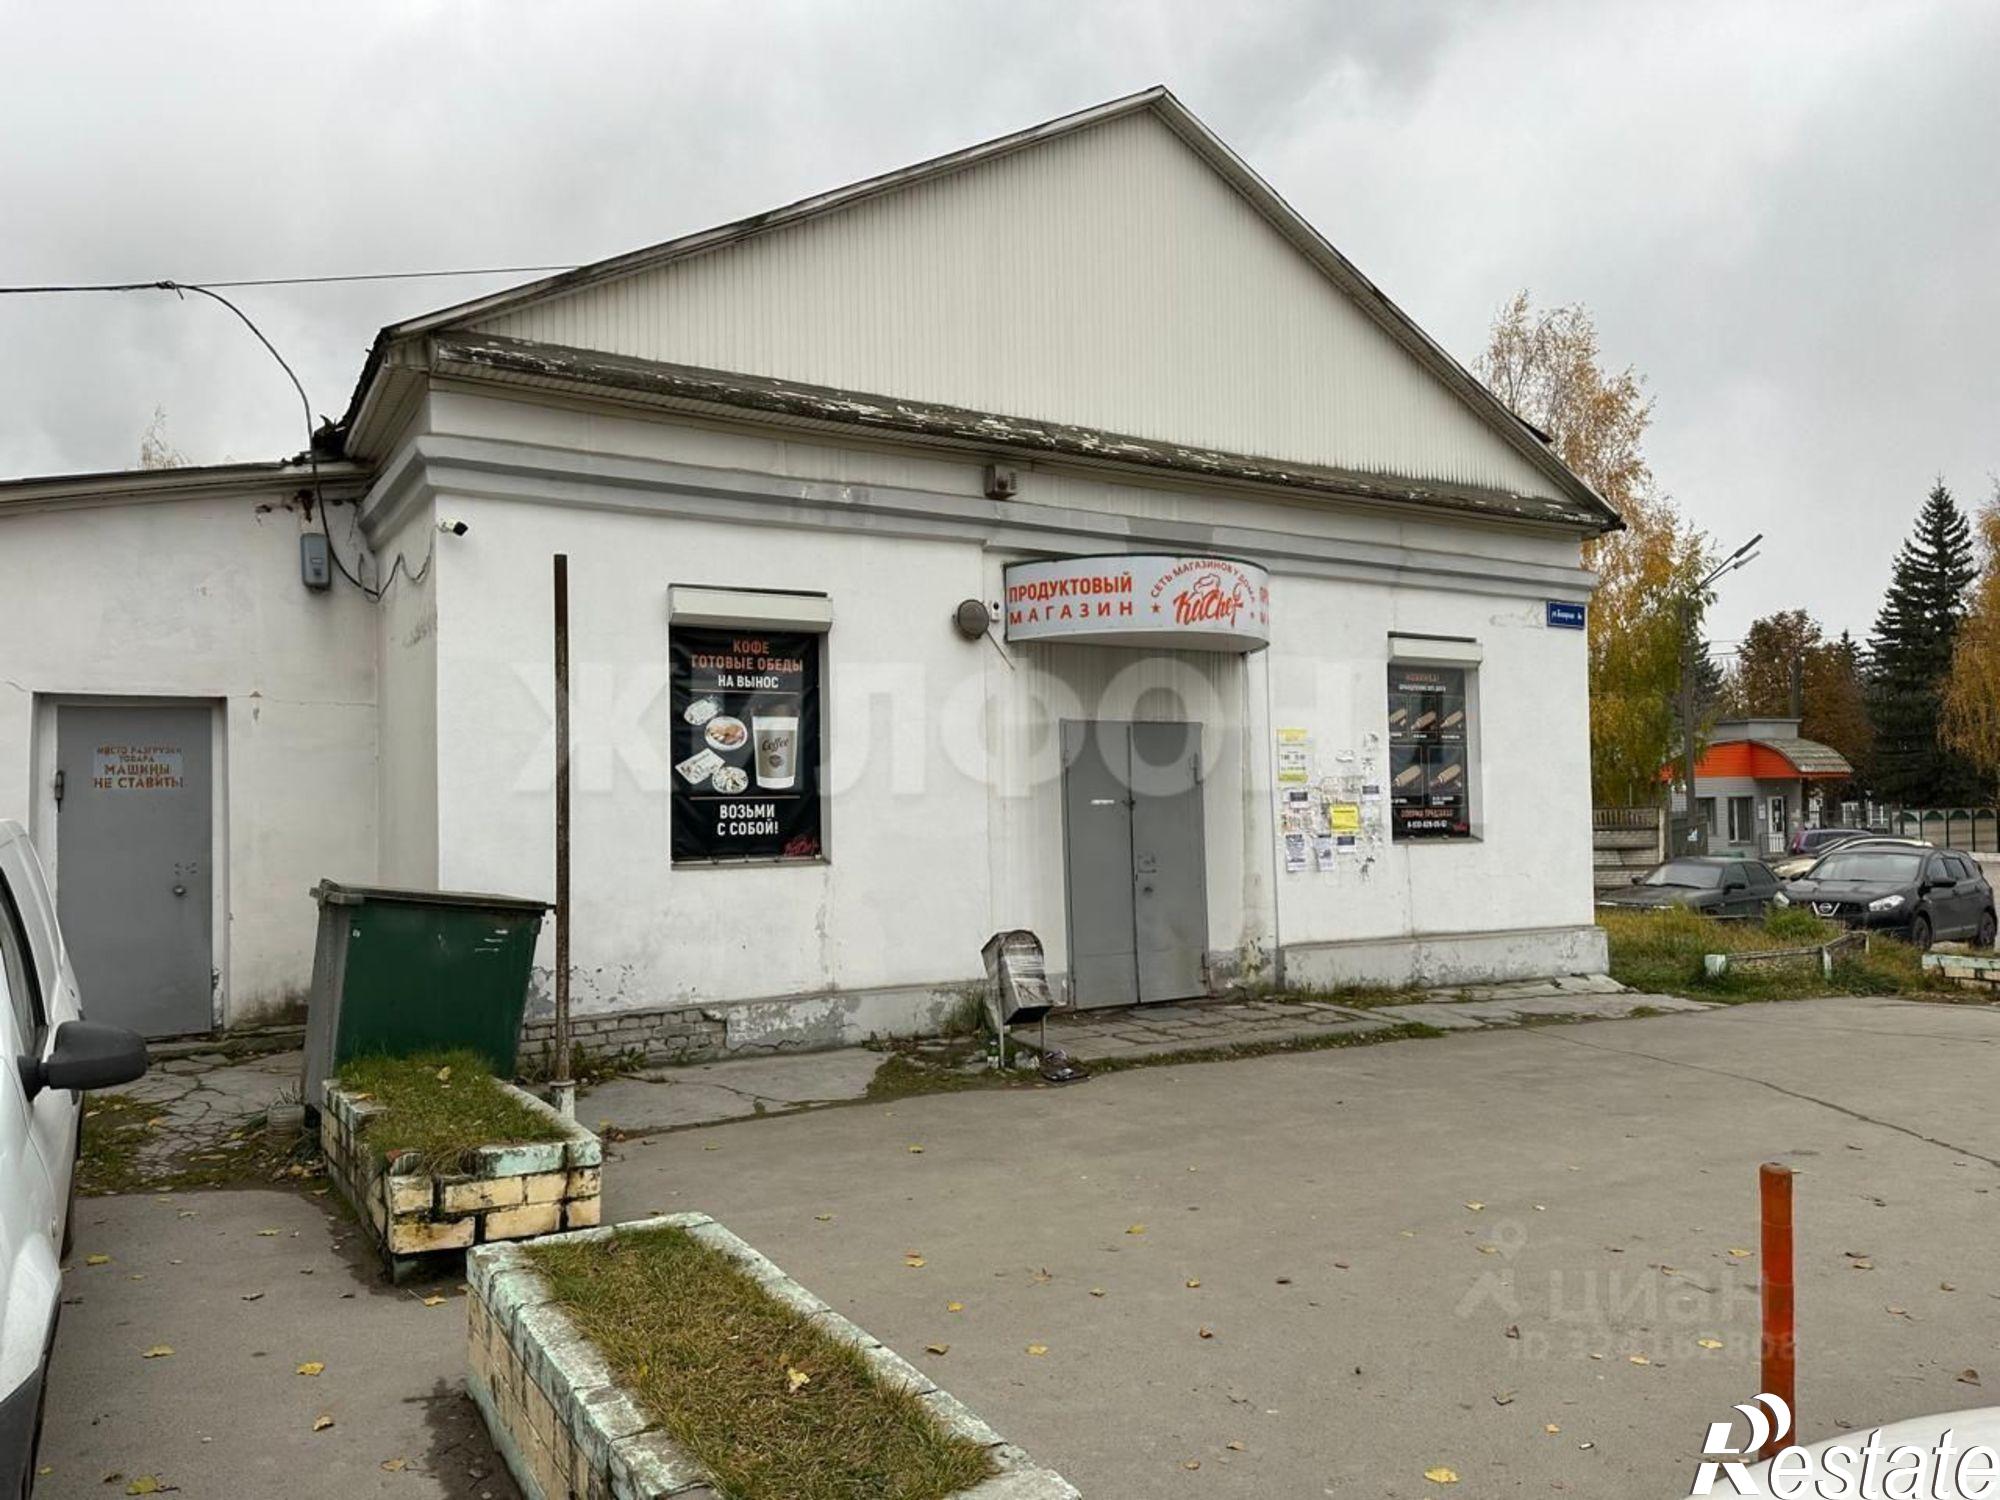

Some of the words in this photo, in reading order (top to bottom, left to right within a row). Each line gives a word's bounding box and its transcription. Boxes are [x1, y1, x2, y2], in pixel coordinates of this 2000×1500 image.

[1008, 571, 1133, 604] ПРОДУКТОВЫЙ
[1150, 574, 1173, 598] СЕТЬ
[1009, 601, 1134, 625] МАГАЗИН
[732, 639, 770, 656] КОФЕ
[691, 653, 755, 672] ГОТОВЫЕ
[757, 656, 804, 672] ОБЕДЫ
[717, 674, 734, 688] НА
[737, 674, 779, 689] ВЫНОС
[103, 763, 170, 776] МАШИНЫ
[93, 776, 112, 789] НЕ
[719, 803, 775, 820] ВОЗЬМИ
[717, 822, 726, 836] С
[729, 818, 779, 836] СОБОЙ!
